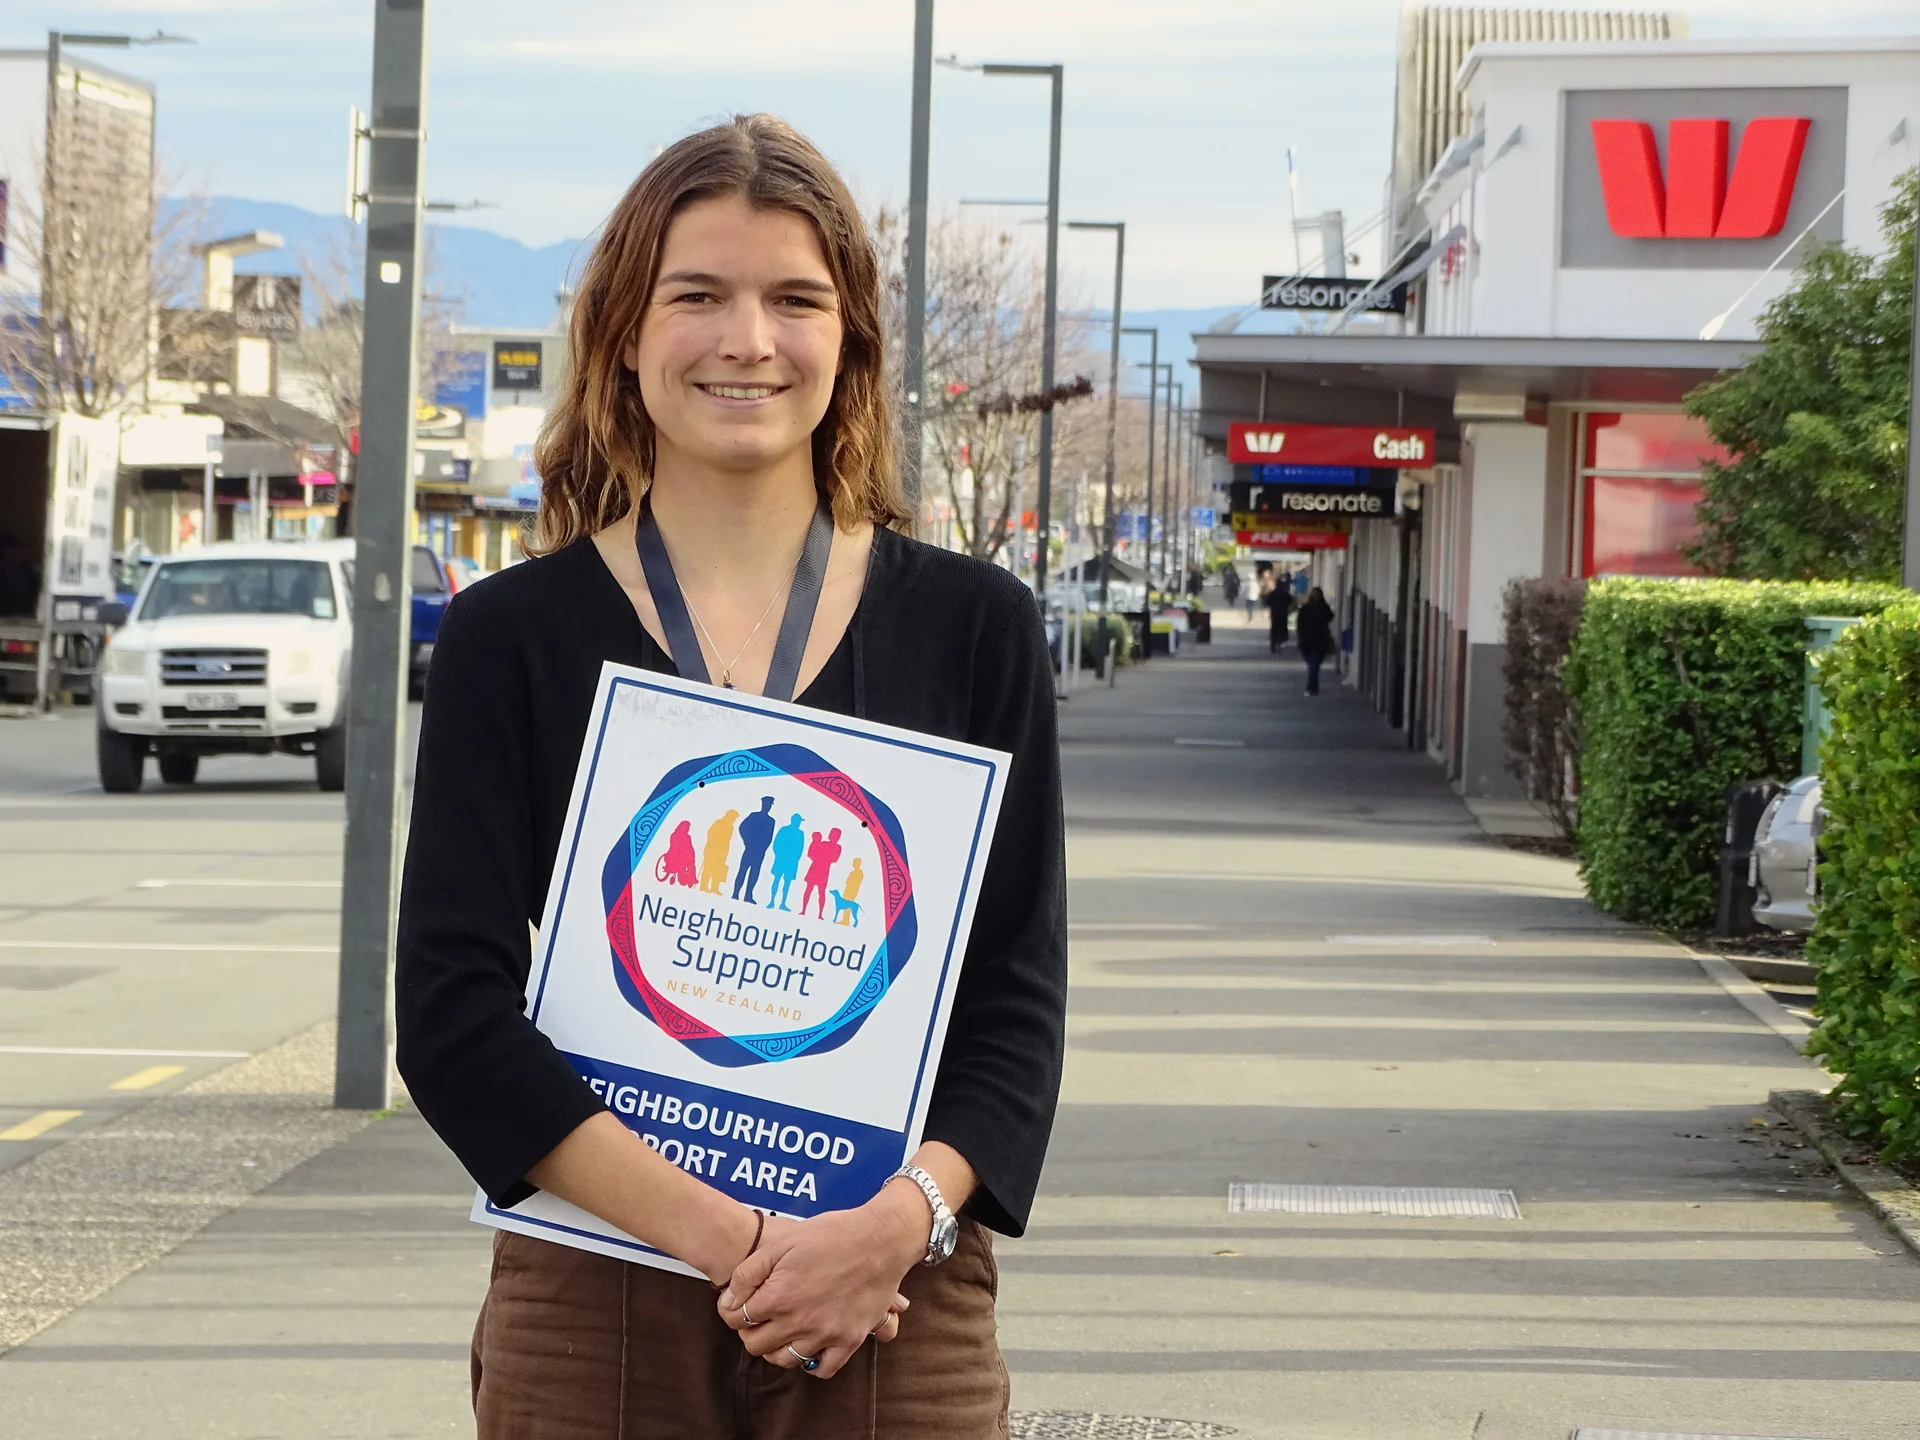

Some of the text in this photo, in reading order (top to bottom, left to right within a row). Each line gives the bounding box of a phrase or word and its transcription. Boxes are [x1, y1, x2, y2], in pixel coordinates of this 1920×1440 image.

[1373, 433, 1425, 460] Cash
[638, 893, 867, 972] Neighbourhood
[672, 934, 815, 997] Support
[666, 979, 803, 1022] NEW ZEALAND
[582, 1075, 855, 1166] EIGHBOURHOOD
[629, 1129, 818, 1202] PORT AREA
